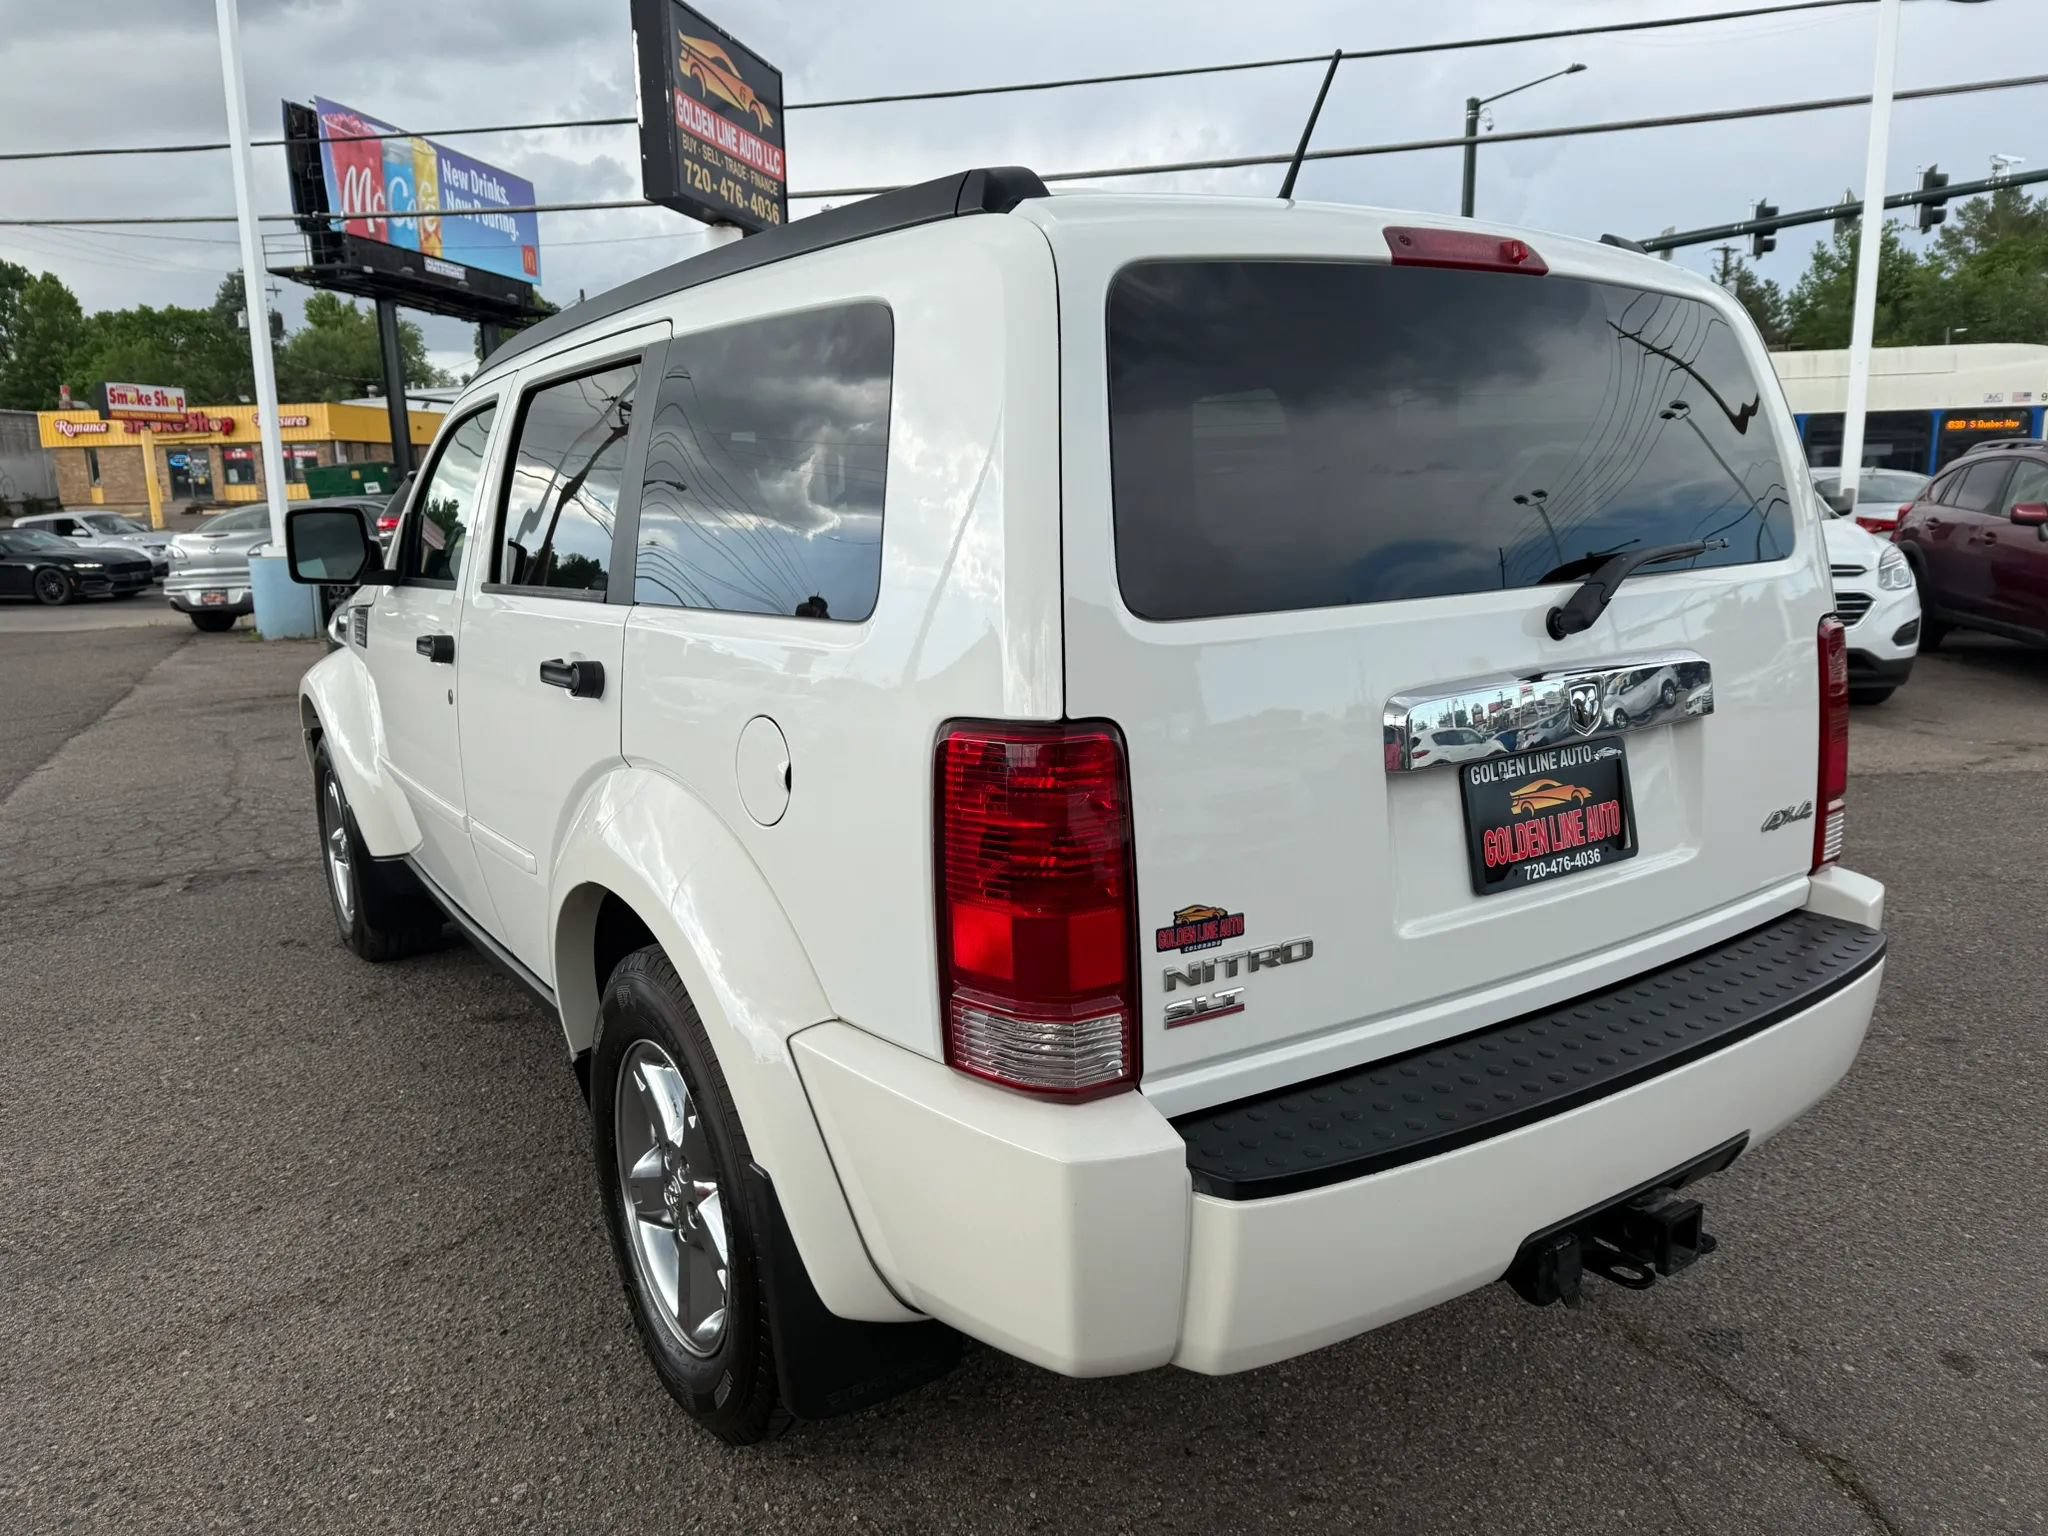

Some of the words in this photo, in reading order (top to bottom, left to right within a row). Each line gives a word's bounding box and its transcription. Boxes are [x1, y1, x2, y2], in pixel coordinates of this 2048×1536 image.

[676, 94, 716, 140] GOLDEN
[715, 117, 738, 153] LINE
[739, 131, 763, 168] AUTO
[763, 144, 781, 176] LLC
[442, 157, 468, 191] New
[470, 168, 510, 206] Drinks.
[682, 133, 697, 154] BUY
[702, 144, 721, 167] SELL
[724, 155, 747, 180] TRADE
[750, 170, 779, 197] FINANCE
[473, 198, 520, 242] Pouring.
[109, 387, 152, 406] Smoke
[154, 389, 184, 412] Shop
[55, 420, 107, 437] Romance
[1470, 757, 1526, 785] GOLDEN
[1528, 751, 1558, 774] LINE
[1560, 745, 1592, 768] AUTO
[1483, 816, 1550, 868] GOLDEN
[1549, 808, 1586, 851] LINE
[1586, 799, 1622, 843] AUTO
[1524, 848, 1602, 881] 720-476-4036
[1158, 924, 1198, 950] GOLDEN
[1197, 920, 1219, 942] LINE
[1219, 915, 1244, 938] AUTO
[1163, 935, 1314, 992] NITRO
[1164, 986, 1245, 1019] SLT
